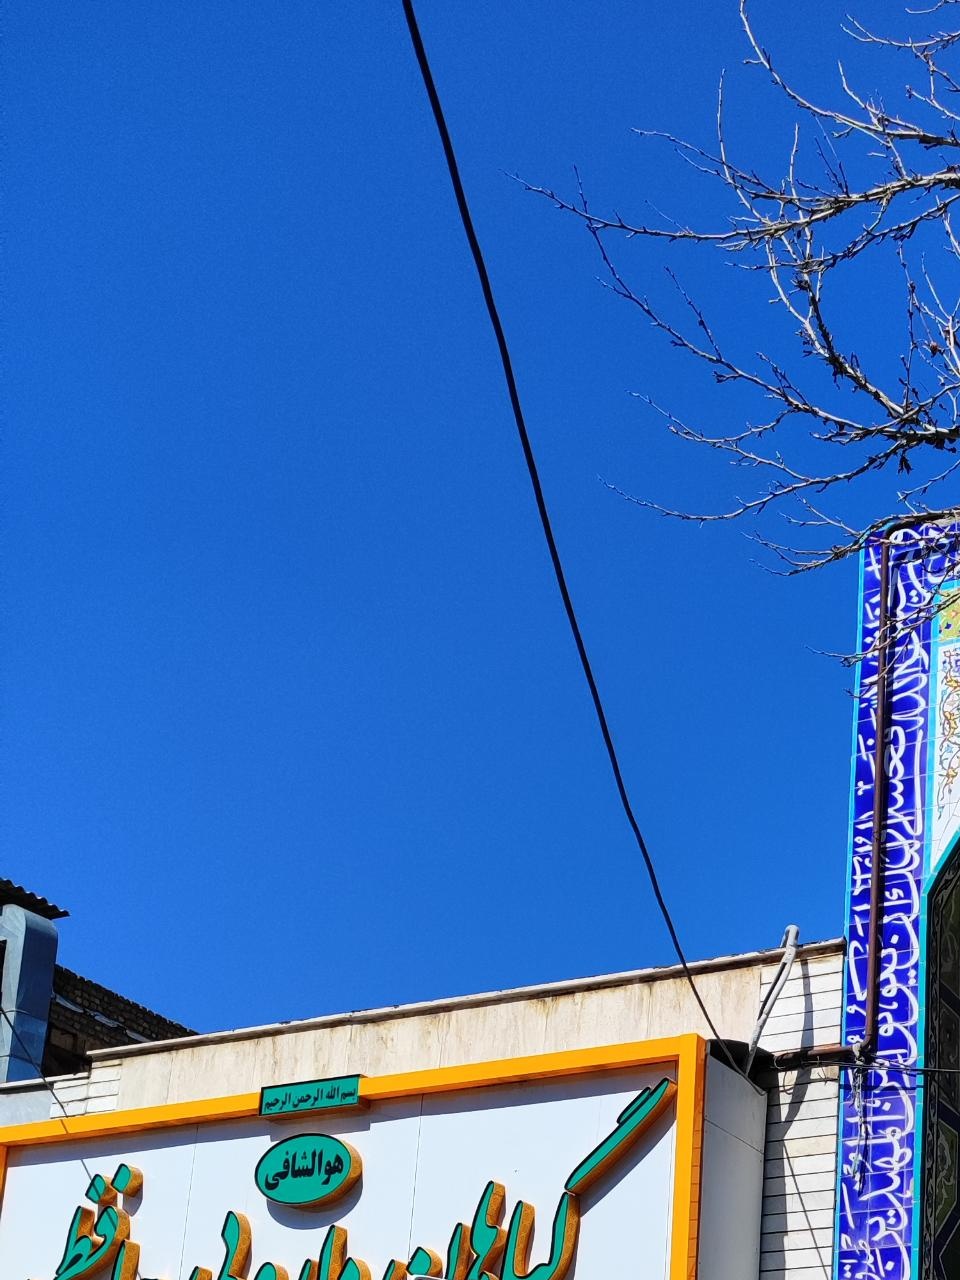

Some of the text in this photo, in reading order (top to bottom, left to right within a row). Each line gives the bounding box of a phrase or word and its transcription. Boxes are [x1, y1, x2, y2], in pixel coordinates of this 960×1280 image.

[291, 1087, 324, 1109] الرحمن
[325, 1084, 340, 1100] الله
[341, 1087, 356, 1102] بسم
